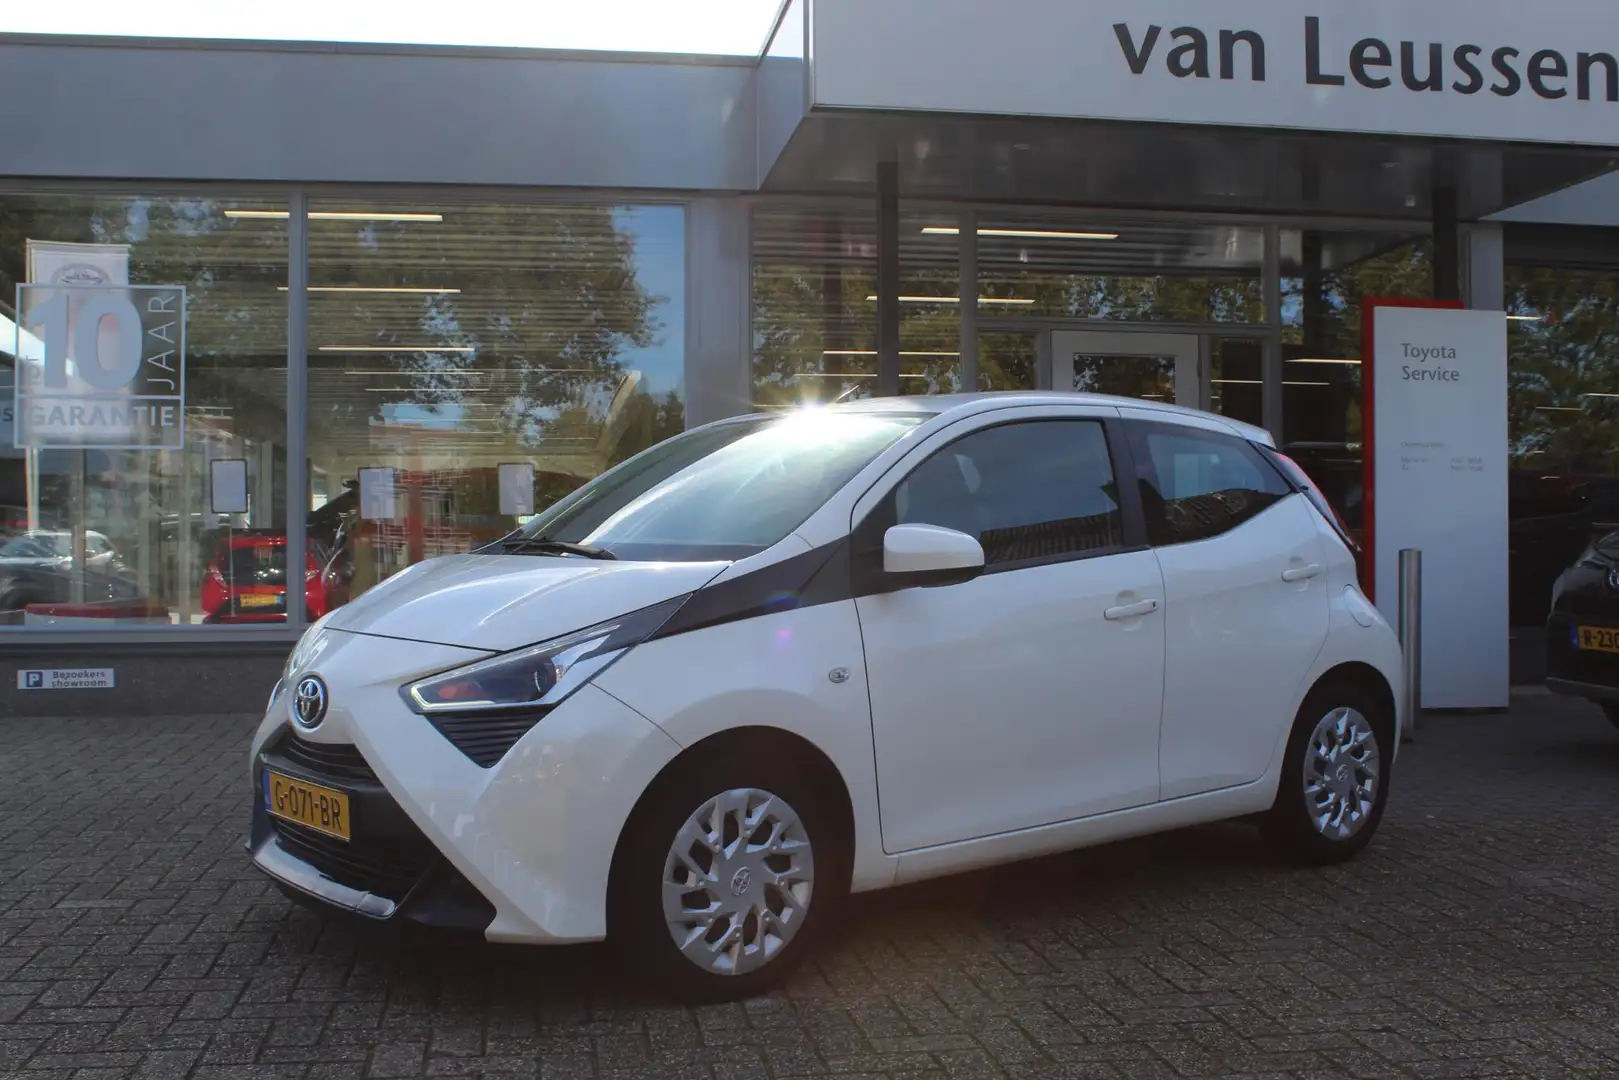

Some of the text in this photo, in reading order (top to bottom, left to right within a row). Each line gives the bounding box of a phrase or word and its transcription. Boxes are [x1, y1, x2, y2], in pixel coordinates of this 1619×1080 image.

[1112, 16, 1619, 101] van Leussen
[26, 293, 144, 391] 10
[147, 294, 177, 391] JAAR
[1400, 342, 1457, 362] Toyota
[1401, 365, 1460, 382] Service
[29, 405, 175, 427] GARANTIE
[51, 679, 107, 688] showroom
[52, 670, 106, 680] Bezoekers
[275, 780, 343, 831] G-071-BR
